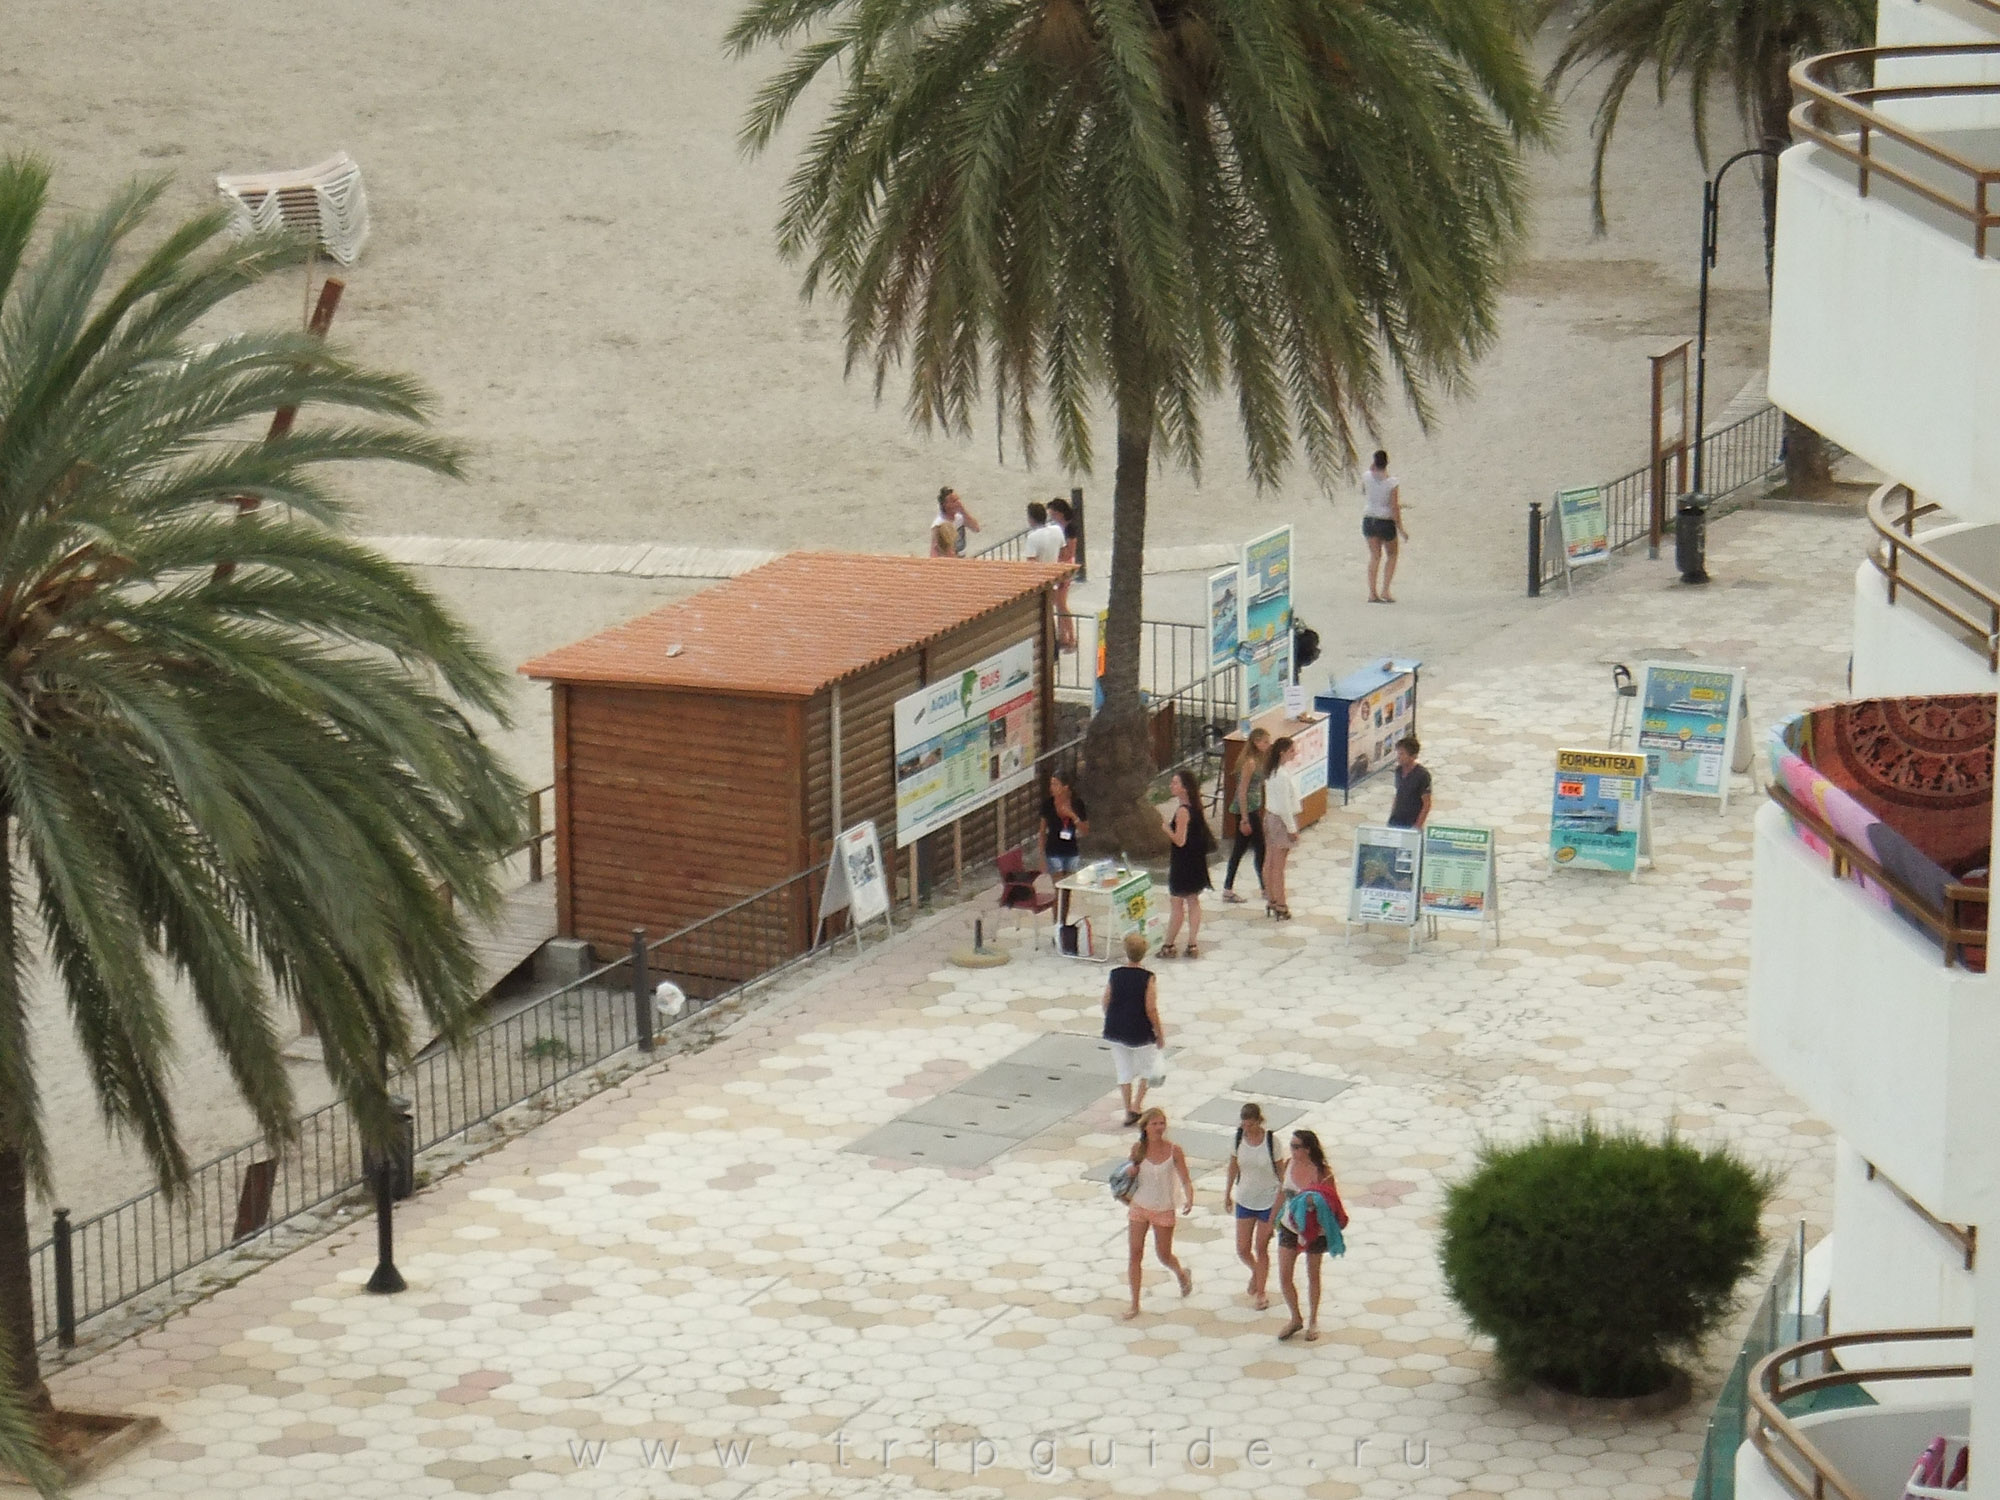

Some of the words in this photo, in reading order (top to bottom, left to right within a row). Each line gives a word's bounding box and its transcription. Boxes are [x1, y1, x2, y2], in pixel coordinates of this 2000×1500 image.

[930, 689, 959, 712] AQUA
[980, 669, 1000, 690] BUS
[1560, 753, 1637, 770] FORMENTERA
[1429, 828, 1485, 842] Formentera
